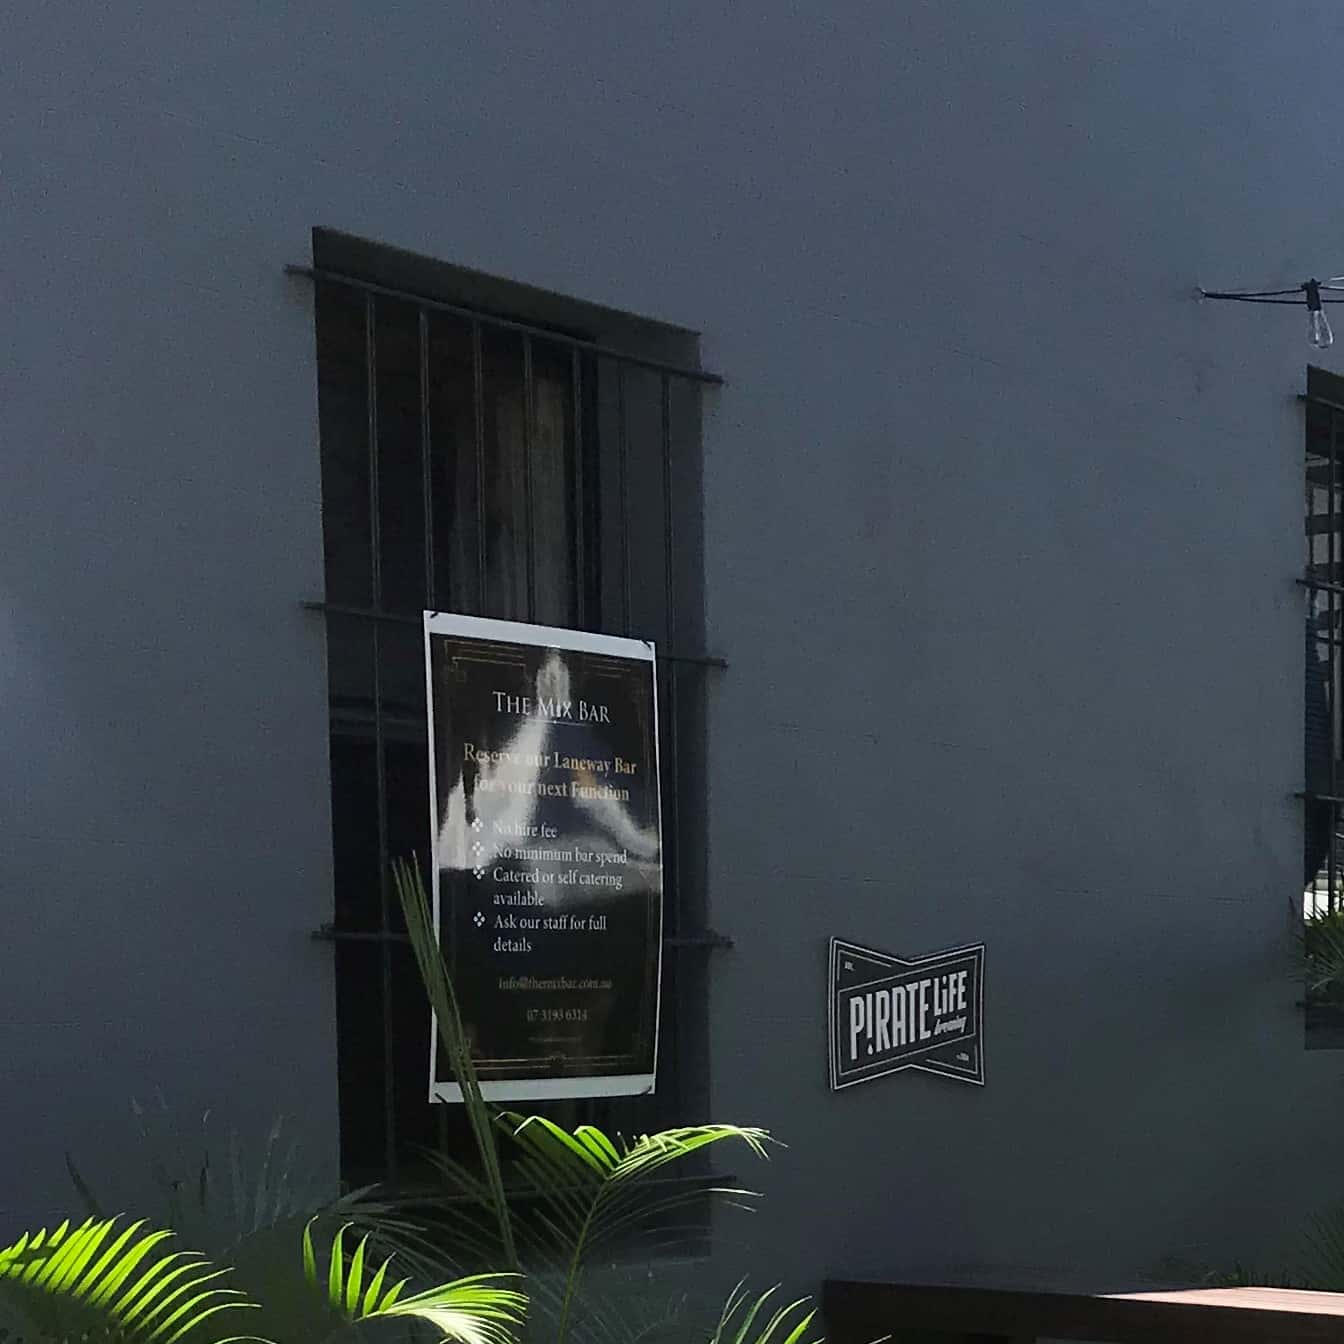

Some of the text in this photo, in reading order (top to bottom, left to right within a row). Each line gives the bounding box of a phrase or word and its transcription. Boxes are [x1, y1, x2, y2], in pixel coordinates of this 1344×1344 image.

[492, 690, 611, 724] THE MIX BAR
[554, 751, 612, 778] Laneway
[614, 757, 637, 775] Bar
[537, 779, 569, 797] next
[571, 780, 631, 802] Function
[541, 821, 558, 839] fee
[493, 842, 628, 868] No minimum bar spend
[493, 866, 624, 890] Catered or self catering
[493, 890, 545, 907] available
[493, 914, 607, 931] Ask our staff for full
[493, 937, 533, 953] details
